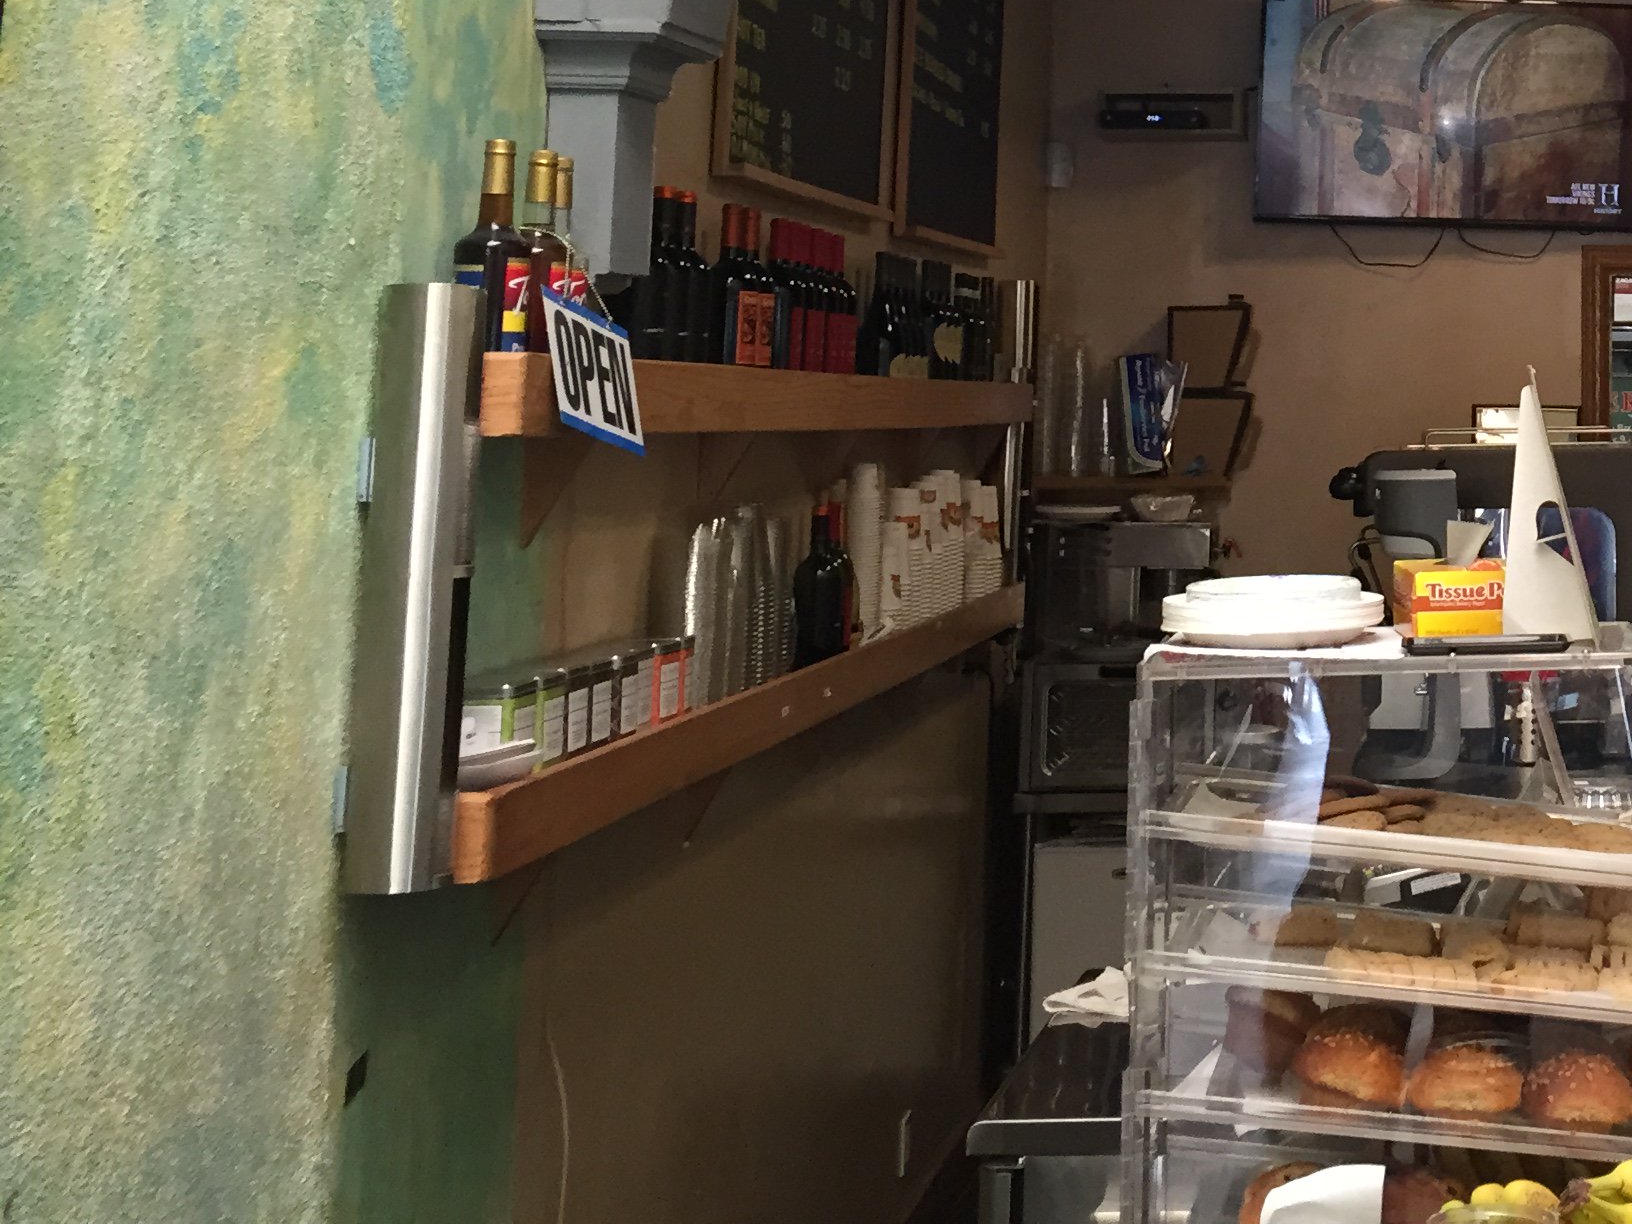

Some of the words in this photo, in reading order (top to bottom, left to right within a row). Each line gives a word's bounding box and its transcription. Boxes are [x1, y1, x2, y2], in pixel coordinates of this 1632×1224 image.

[553, 308, 637, 436] OPEN
[1425, 582, 1486, 600] Tissue
[1488, 581, 1505, 599] P
